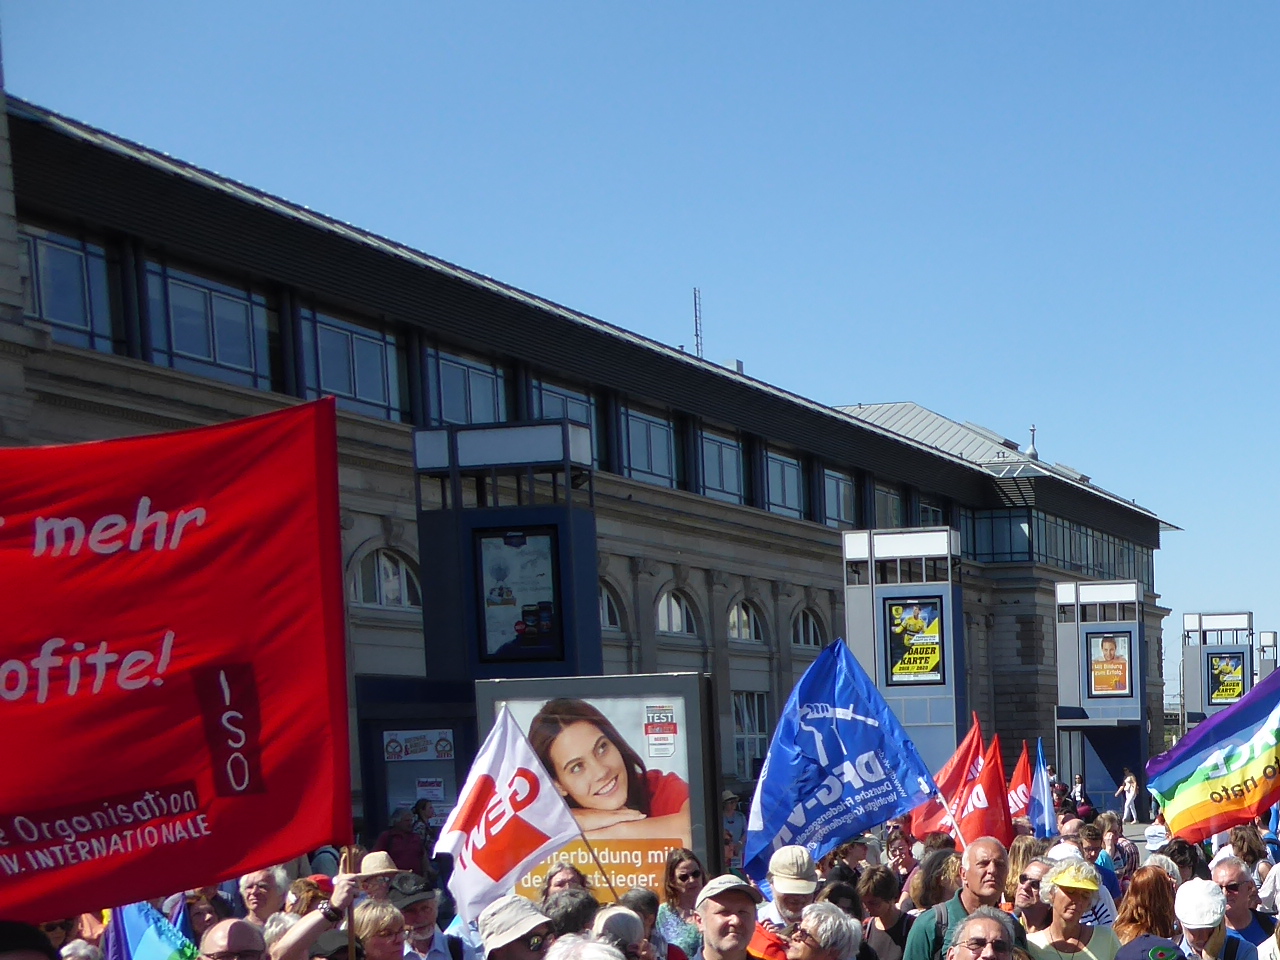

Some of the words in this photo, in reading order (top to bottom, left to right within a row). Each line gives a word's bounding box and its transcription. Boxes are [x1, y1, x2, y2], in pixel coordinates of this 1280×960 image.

[33, 495, 206, 557] mehr
[0, 629, 175, 704] ofite!
[900, 656, 930, 665] KARTE
[908, 646, 937, 656] DAUER
[647, 713, 673, 723] TEST
[14, 789, 197, 843] Organisation
[26, 814, 212, 870] INTERNATIONALE
